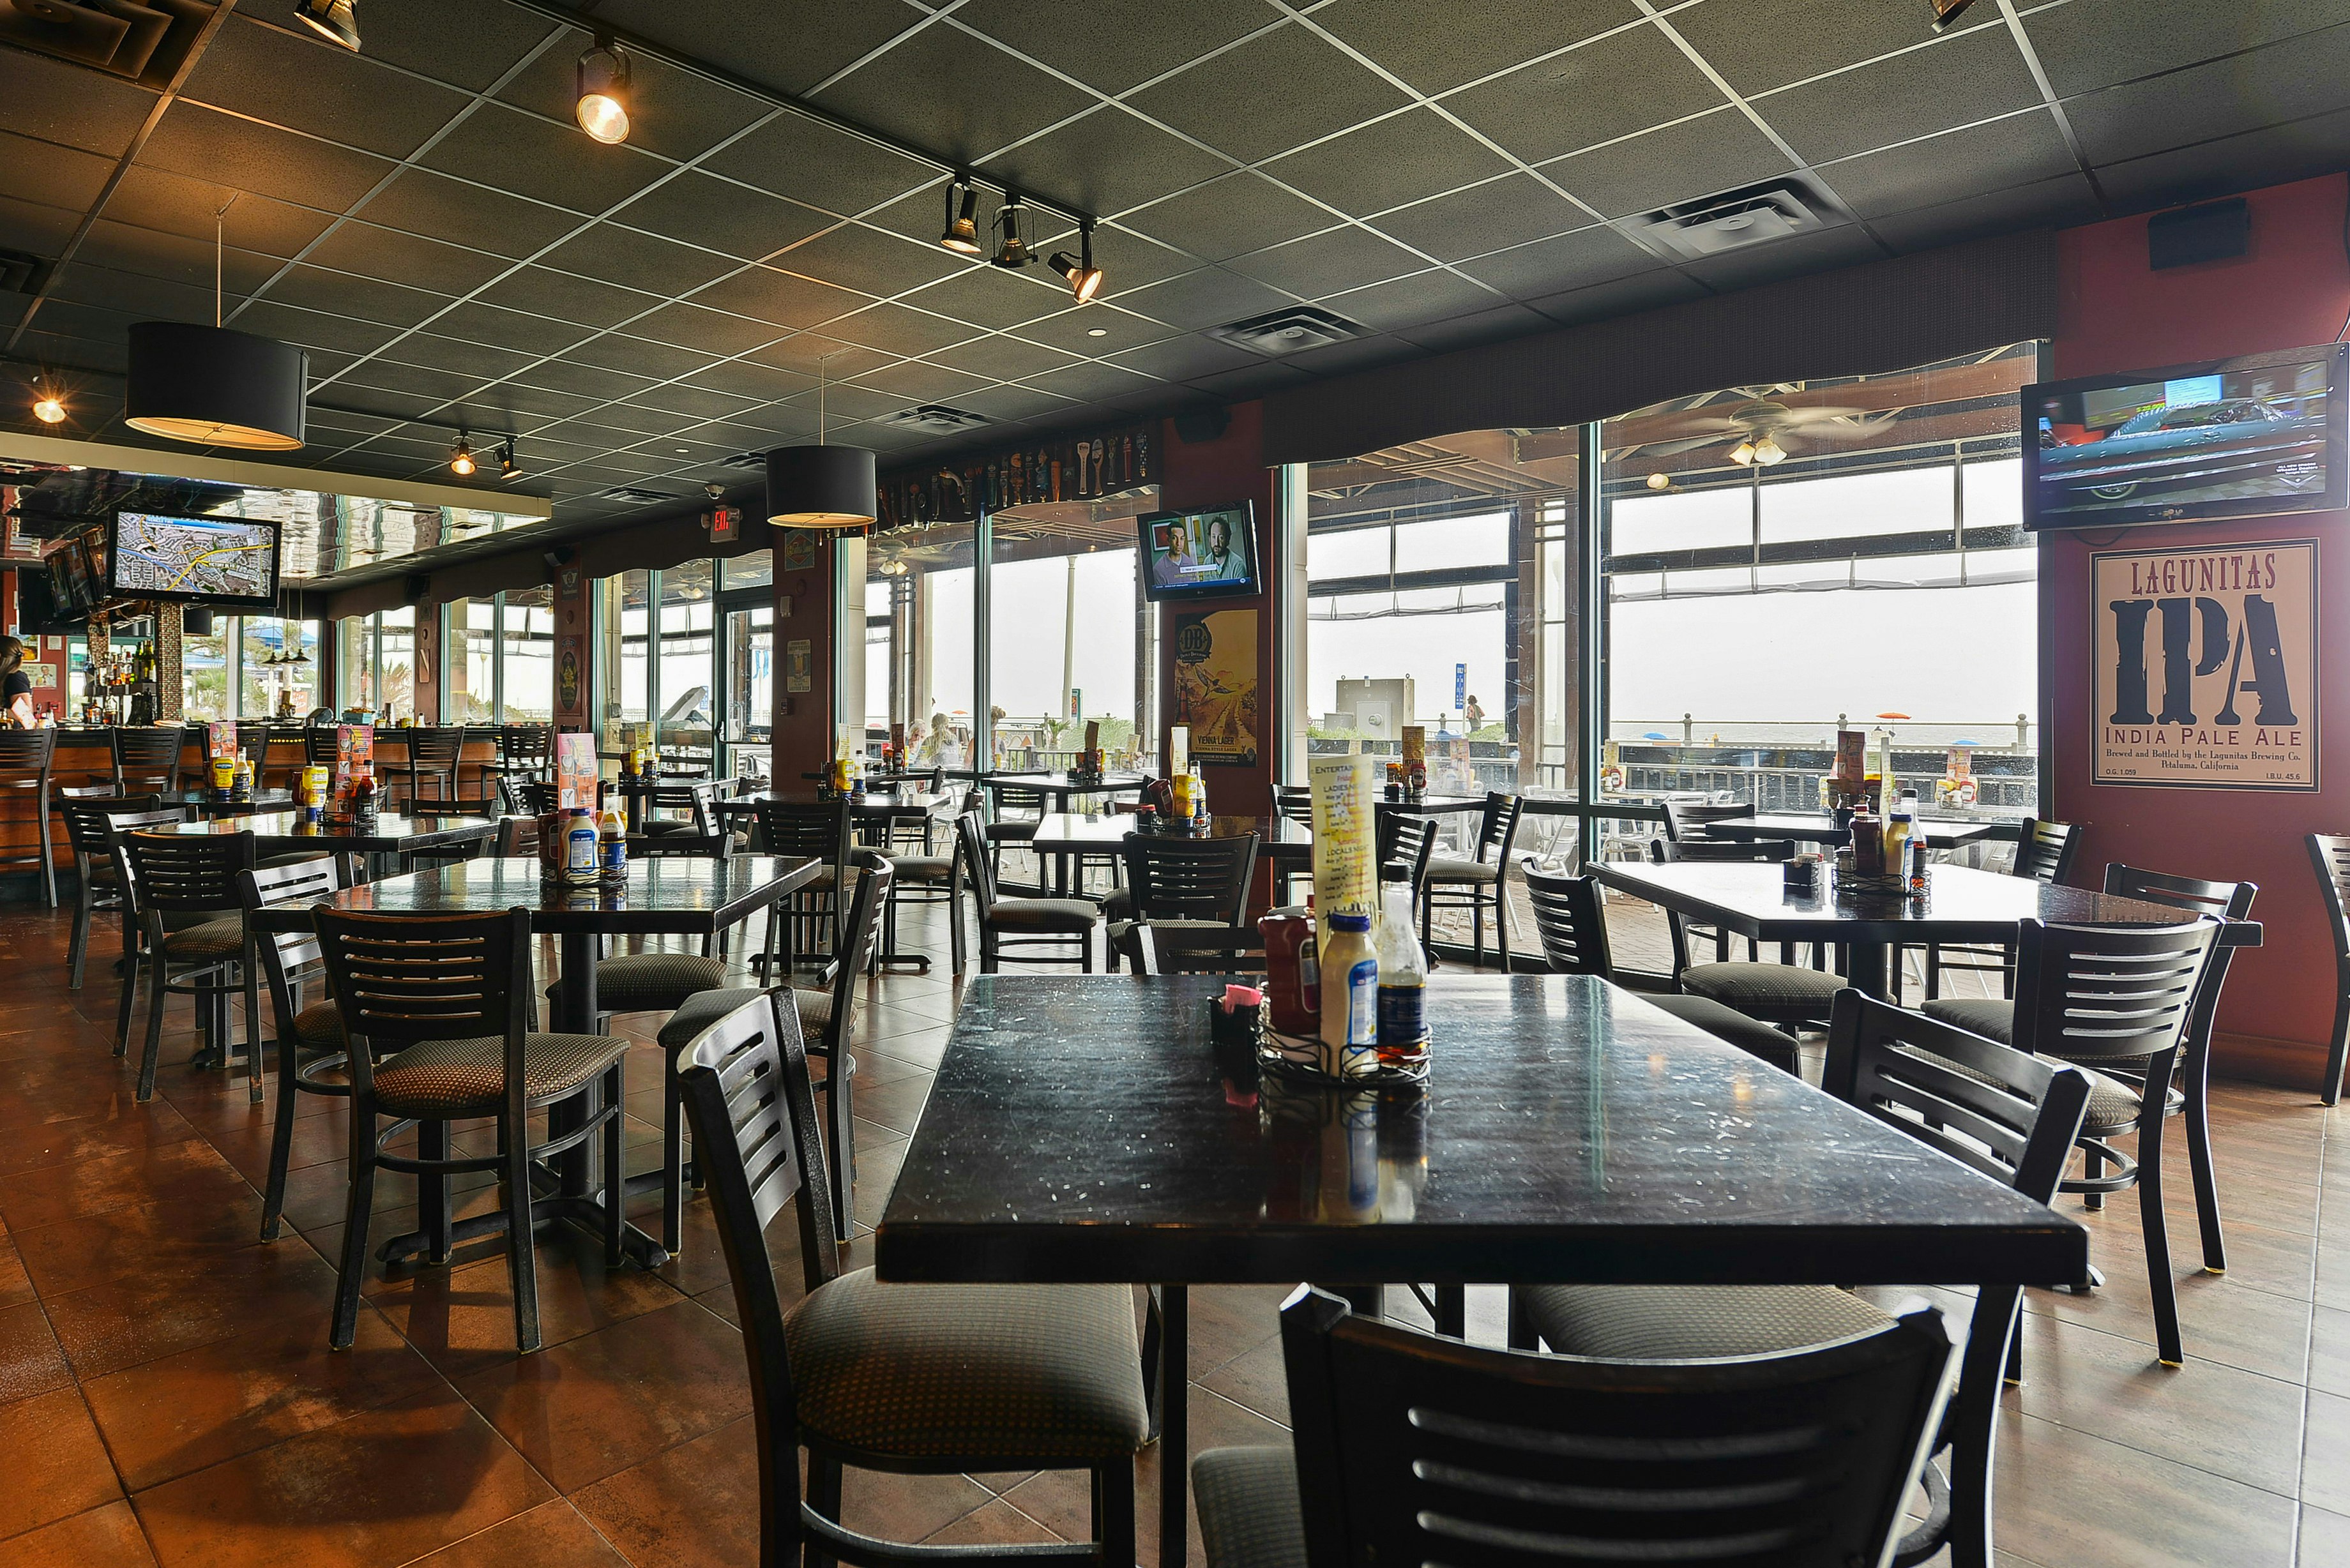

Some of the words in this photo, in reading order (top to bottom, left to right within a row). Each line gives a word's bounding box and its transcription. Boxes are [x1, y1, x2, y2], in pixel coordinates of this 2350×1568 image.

[2131, 553, 2277, 596] LAGUNITAS
[1184, 628, 1202, 649] DB
[2109, 594, 2299, 725] IPA
[1197, 735, 1217, 744] VIENNA
[1218, 735, 1234, 745] LAGER
[2105, 727, 2166, 744] INDIA
[2181, 728, 2239, 745] PALE
[2255, 728, 2301, 746] ALE
[2106, 748, 2132, 757] Brewed
[2135, 749, 2149, 757] and
[2153, 750, 2179, 758] Bottled
[2182, 750, 2192, 760] by
[2195, 750, 2206, 758] the
[2210, 750, 2248, 760] Lagunitas
[2252, 751, 2285, 762] Brewing
[2288, 751, 2301, 760] Co.
[2162, 760, 2197, 769] Petaluma,
[2200, 760, 2239, 771] California
[1323, 784, 1348, 792] LADIES
